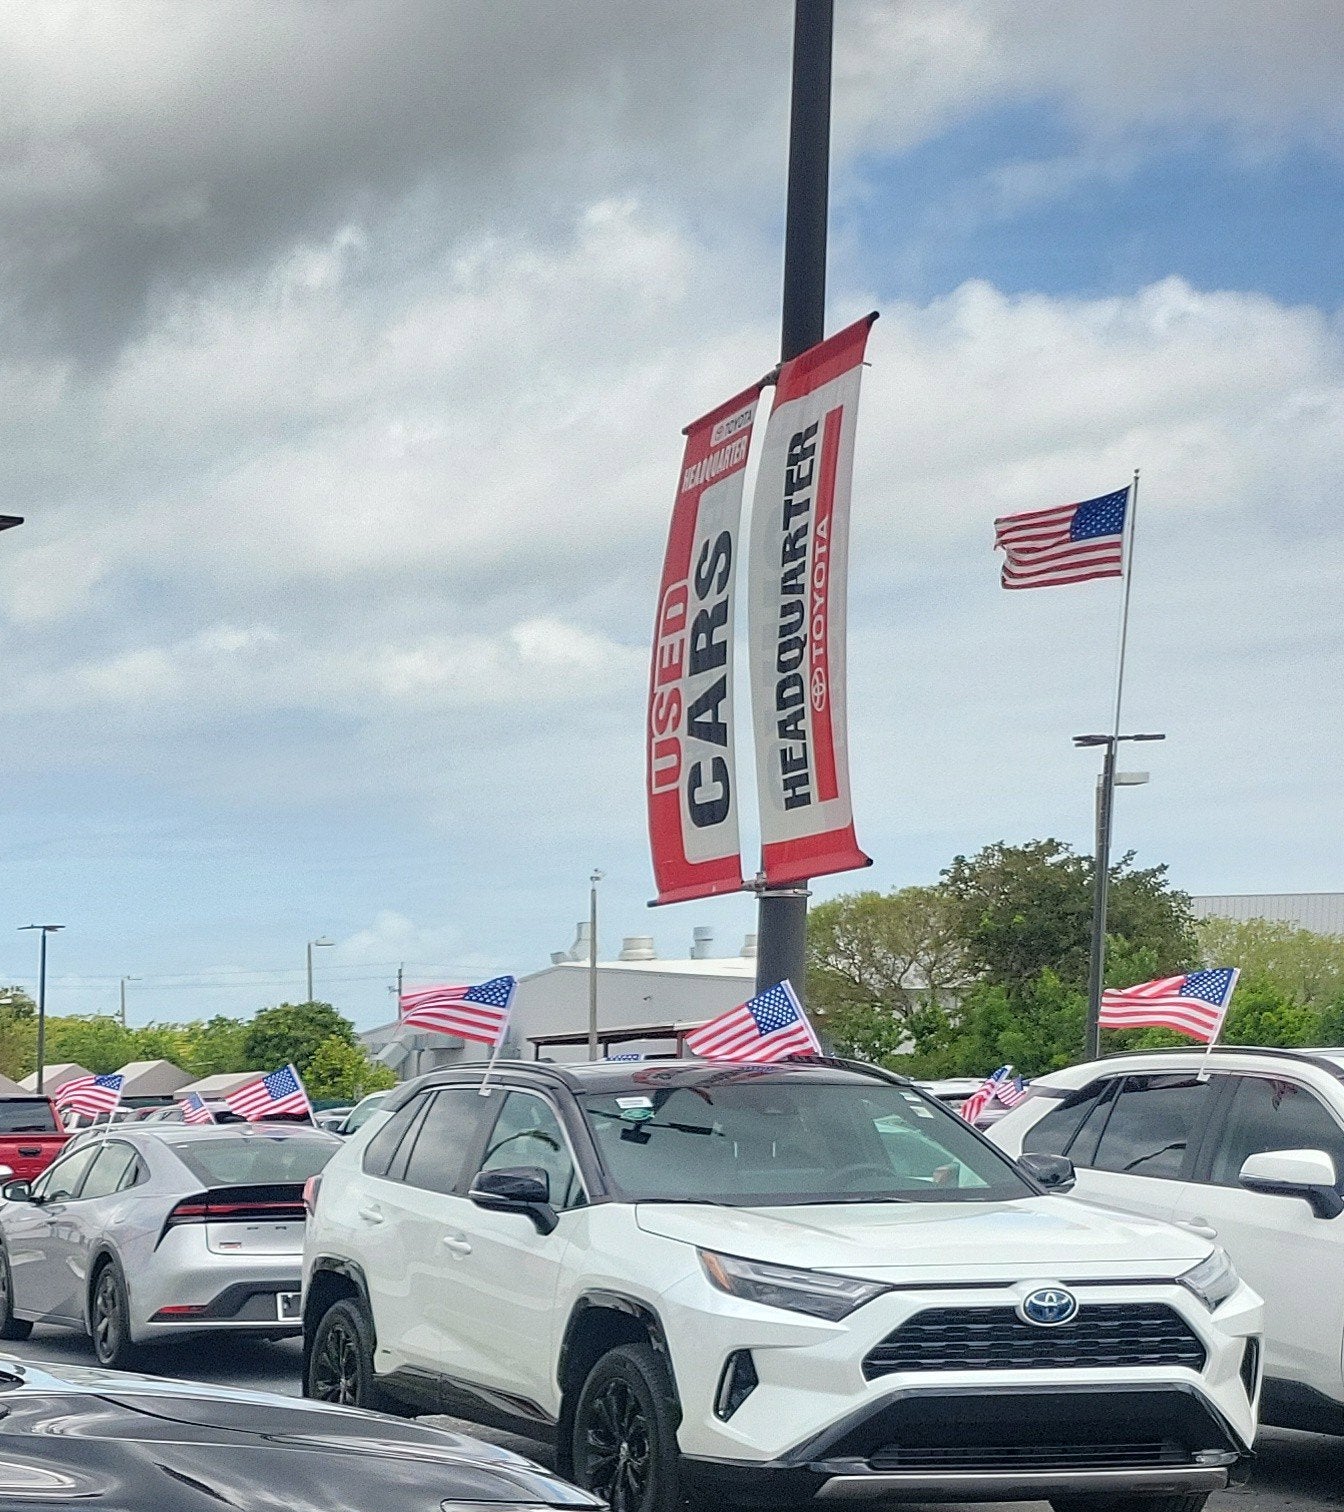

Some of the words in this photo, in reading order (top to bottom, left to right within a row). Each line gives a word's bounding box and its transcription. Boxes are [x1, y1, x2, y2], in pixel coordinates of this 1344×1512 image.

[682, 436, 748, 493] HEADQUARTER
[651, 579, 689, 795] USED
[685, 530, 735, 828] CARS
[776, 421, 820, 811] HEADQUARTER
[811, 516, 831, 658] TOYOTA
